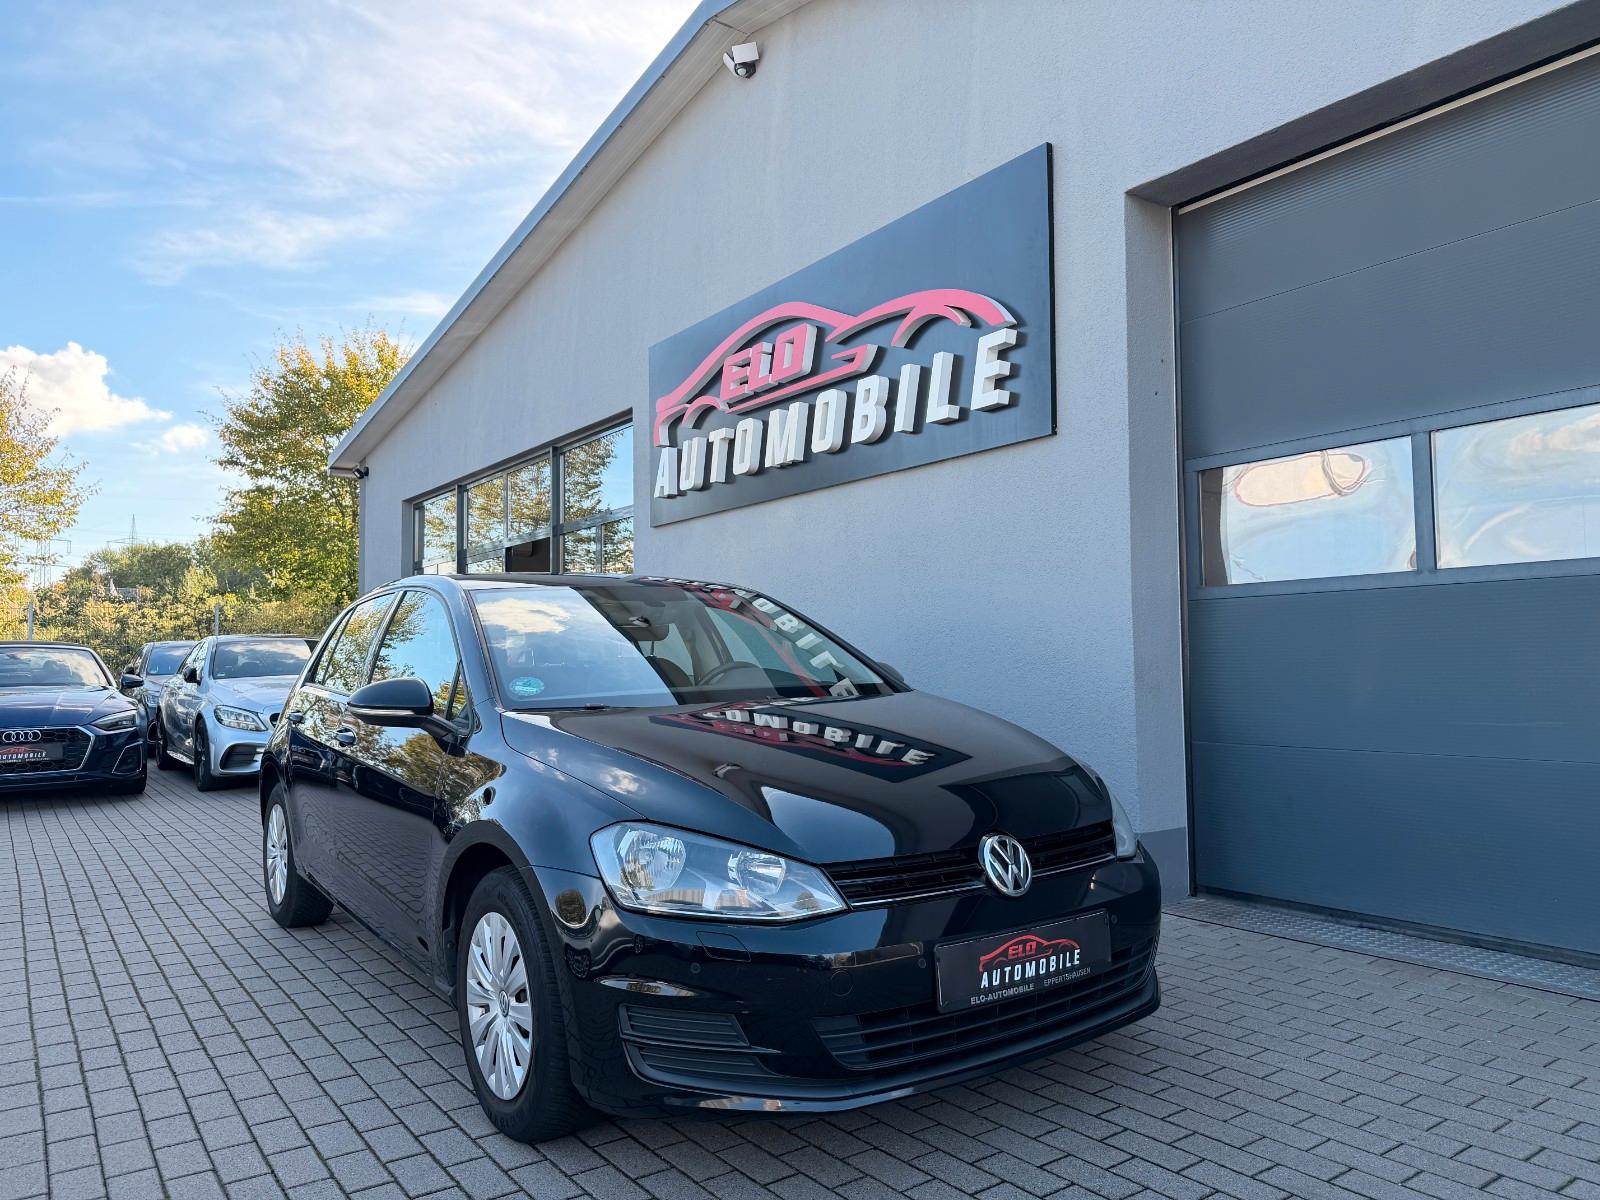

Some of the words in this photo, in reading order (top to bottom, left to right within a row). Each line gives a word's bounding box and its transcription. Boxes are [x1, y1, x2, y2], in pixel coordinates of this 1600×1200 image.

[720, 323, 817, 399] ELO
[653, 327, 1018, 499] AUTOMOBILE
[980, 949, 1081, 989] AUTOMOBILE
[1008, 941, 1037, 959] ELO
[970, 983, 1035, 1005] ELO-AUTOMOBILE
[1043, 967, 1091, 987] EPPERTSHAUSEN
